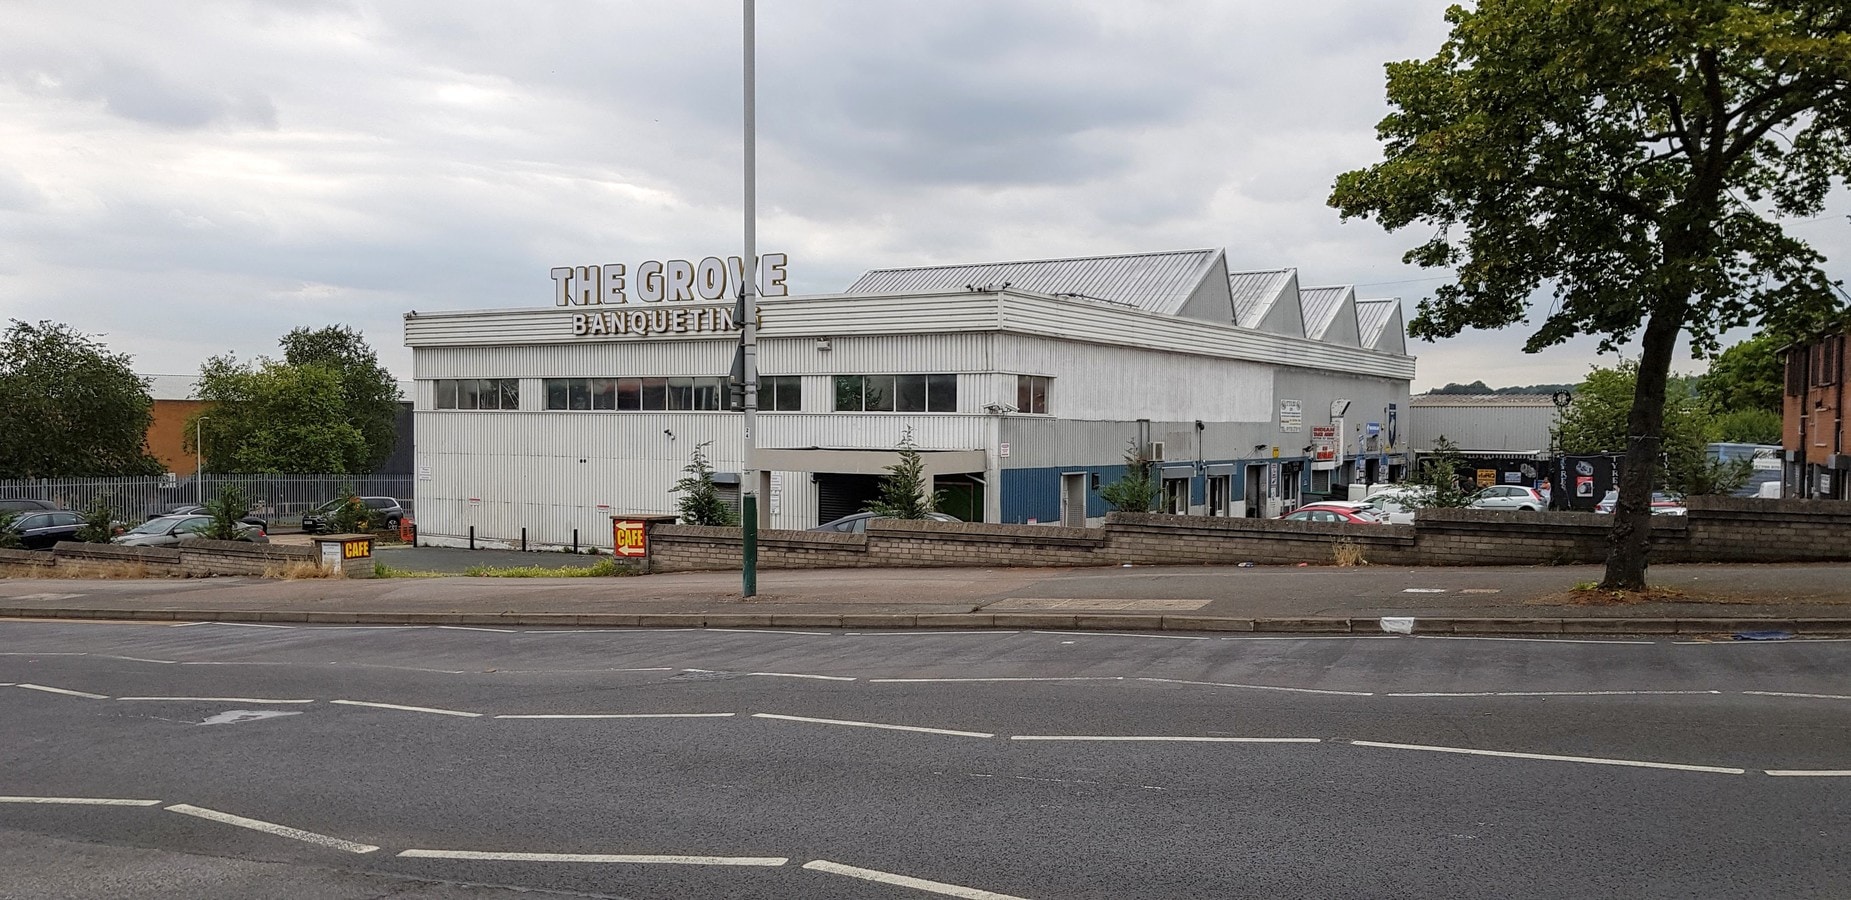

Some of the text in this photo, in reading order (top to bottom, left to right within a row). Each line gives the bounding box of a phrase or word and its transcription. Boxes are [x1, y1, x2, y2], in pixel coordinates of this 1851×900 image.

[551, 264, 626, 306] THE
[572, 307, 761, 336] BANQUETIN
[1611, 456, 1619, 485] TYRE
[345, 541, 369, 558] CAFE
[617, 529, 643, 546] CAFE
